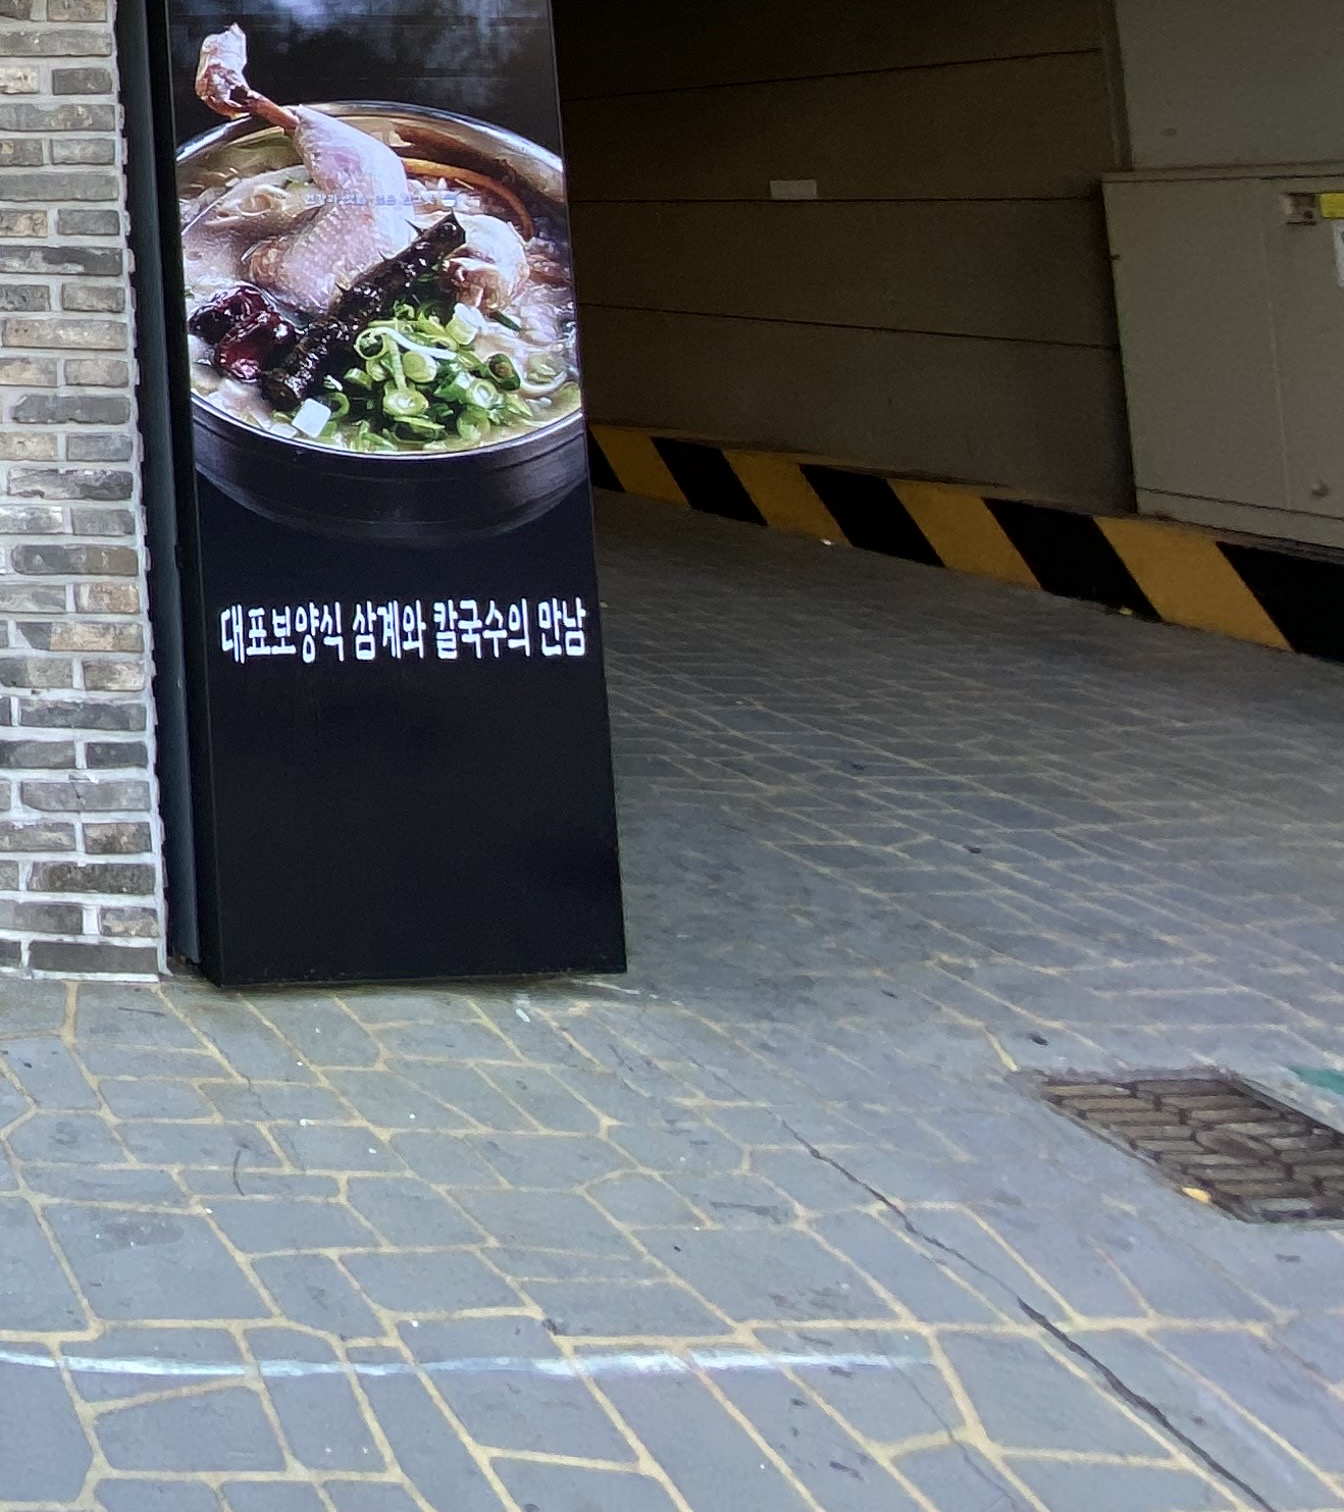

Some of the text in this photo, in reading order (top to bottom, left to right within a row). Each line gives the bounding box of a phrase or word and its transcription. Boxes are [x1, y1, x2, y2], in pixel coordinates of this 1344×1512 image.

[218, 596, 587, 665] 대표보양식 삼계와 칼국수의 만남
